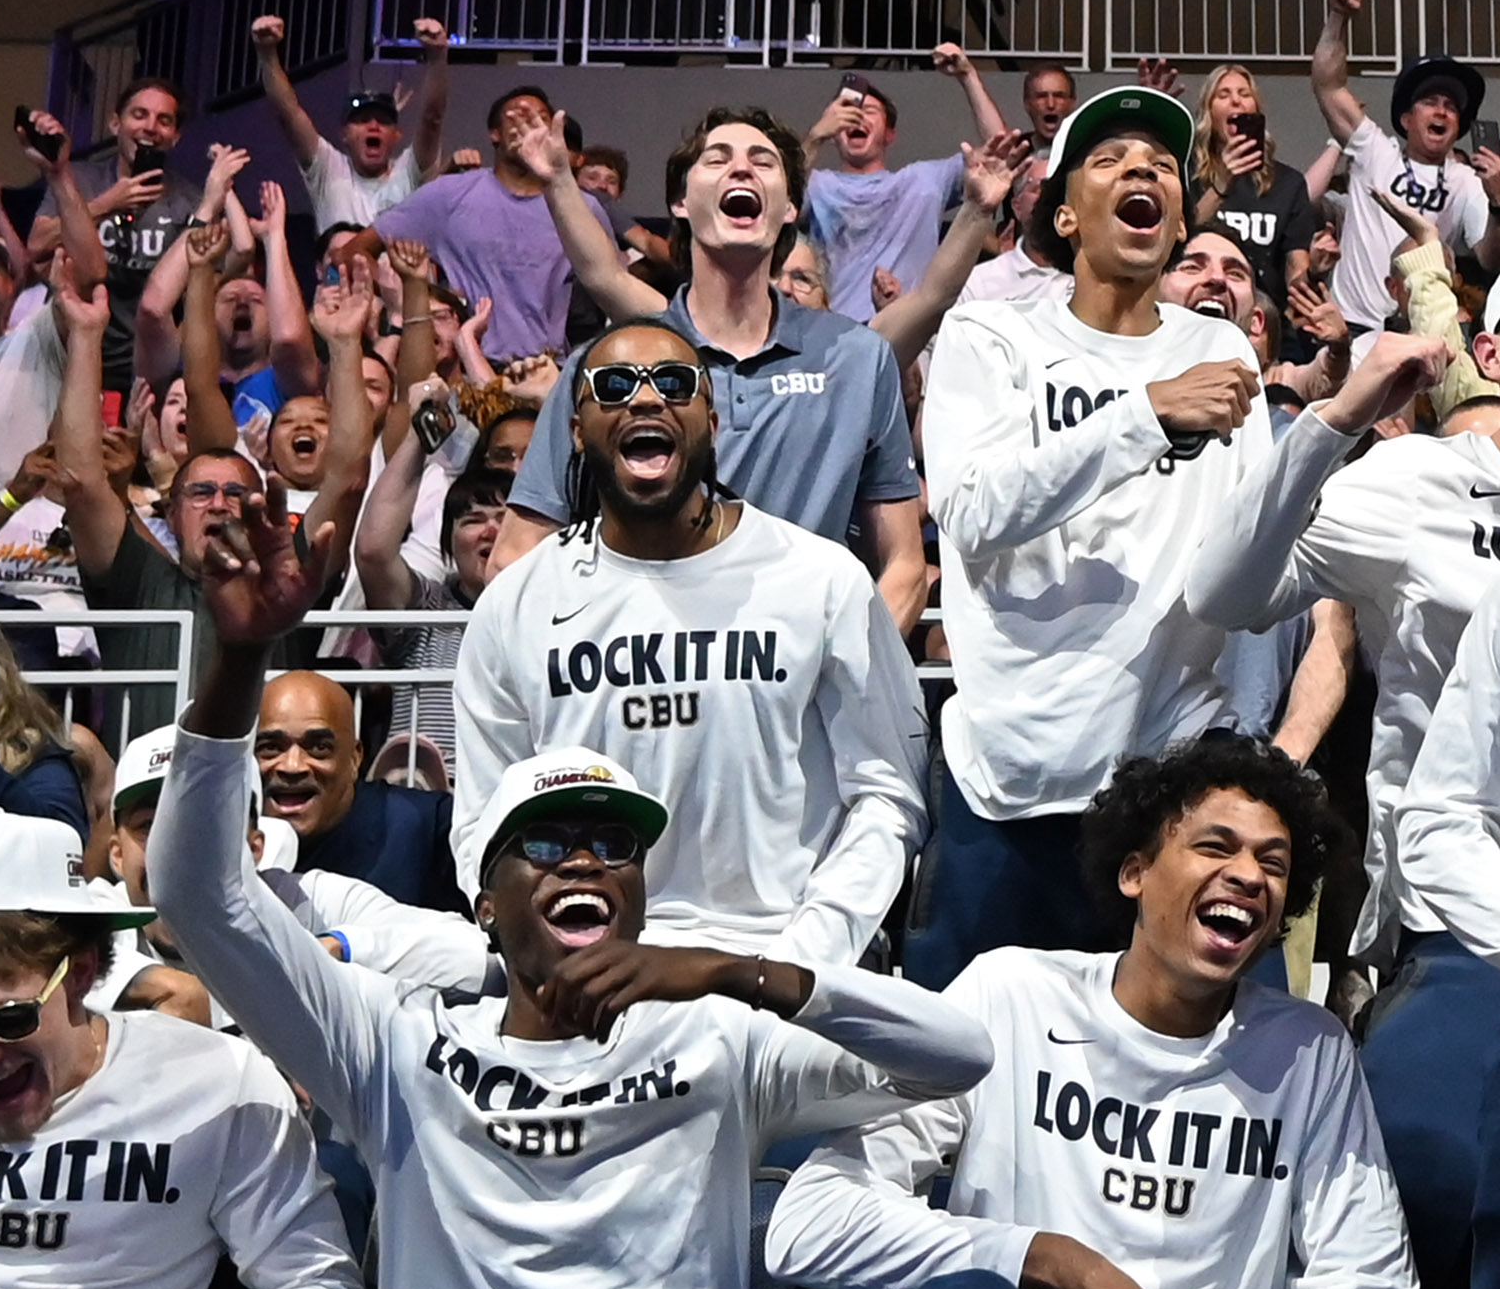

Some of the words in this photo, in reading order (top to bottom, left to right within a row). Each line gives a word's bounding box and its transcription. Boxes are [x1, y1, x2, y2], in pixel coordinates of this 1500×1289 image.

[771, 372, 826, 395] CBU
[548, 633, 667, 698] LOCK
[674, 630, 717, 683] IT
[724, 630, 788, 684] IN.
[621, 691, 700, 730] CBU
[486, 1118, 585, 1157] CBU
[1034, 1069, 1162, 1163] LOCK
[1168, 1111, 1222, 1169] IT
[1225, 1116, 1289, 1181] IN.
[40, 1140, 98, 1201] IT
[103, 1141, 181, 1204] IN.
[1102, 1166, 1195, 1216] CBU
